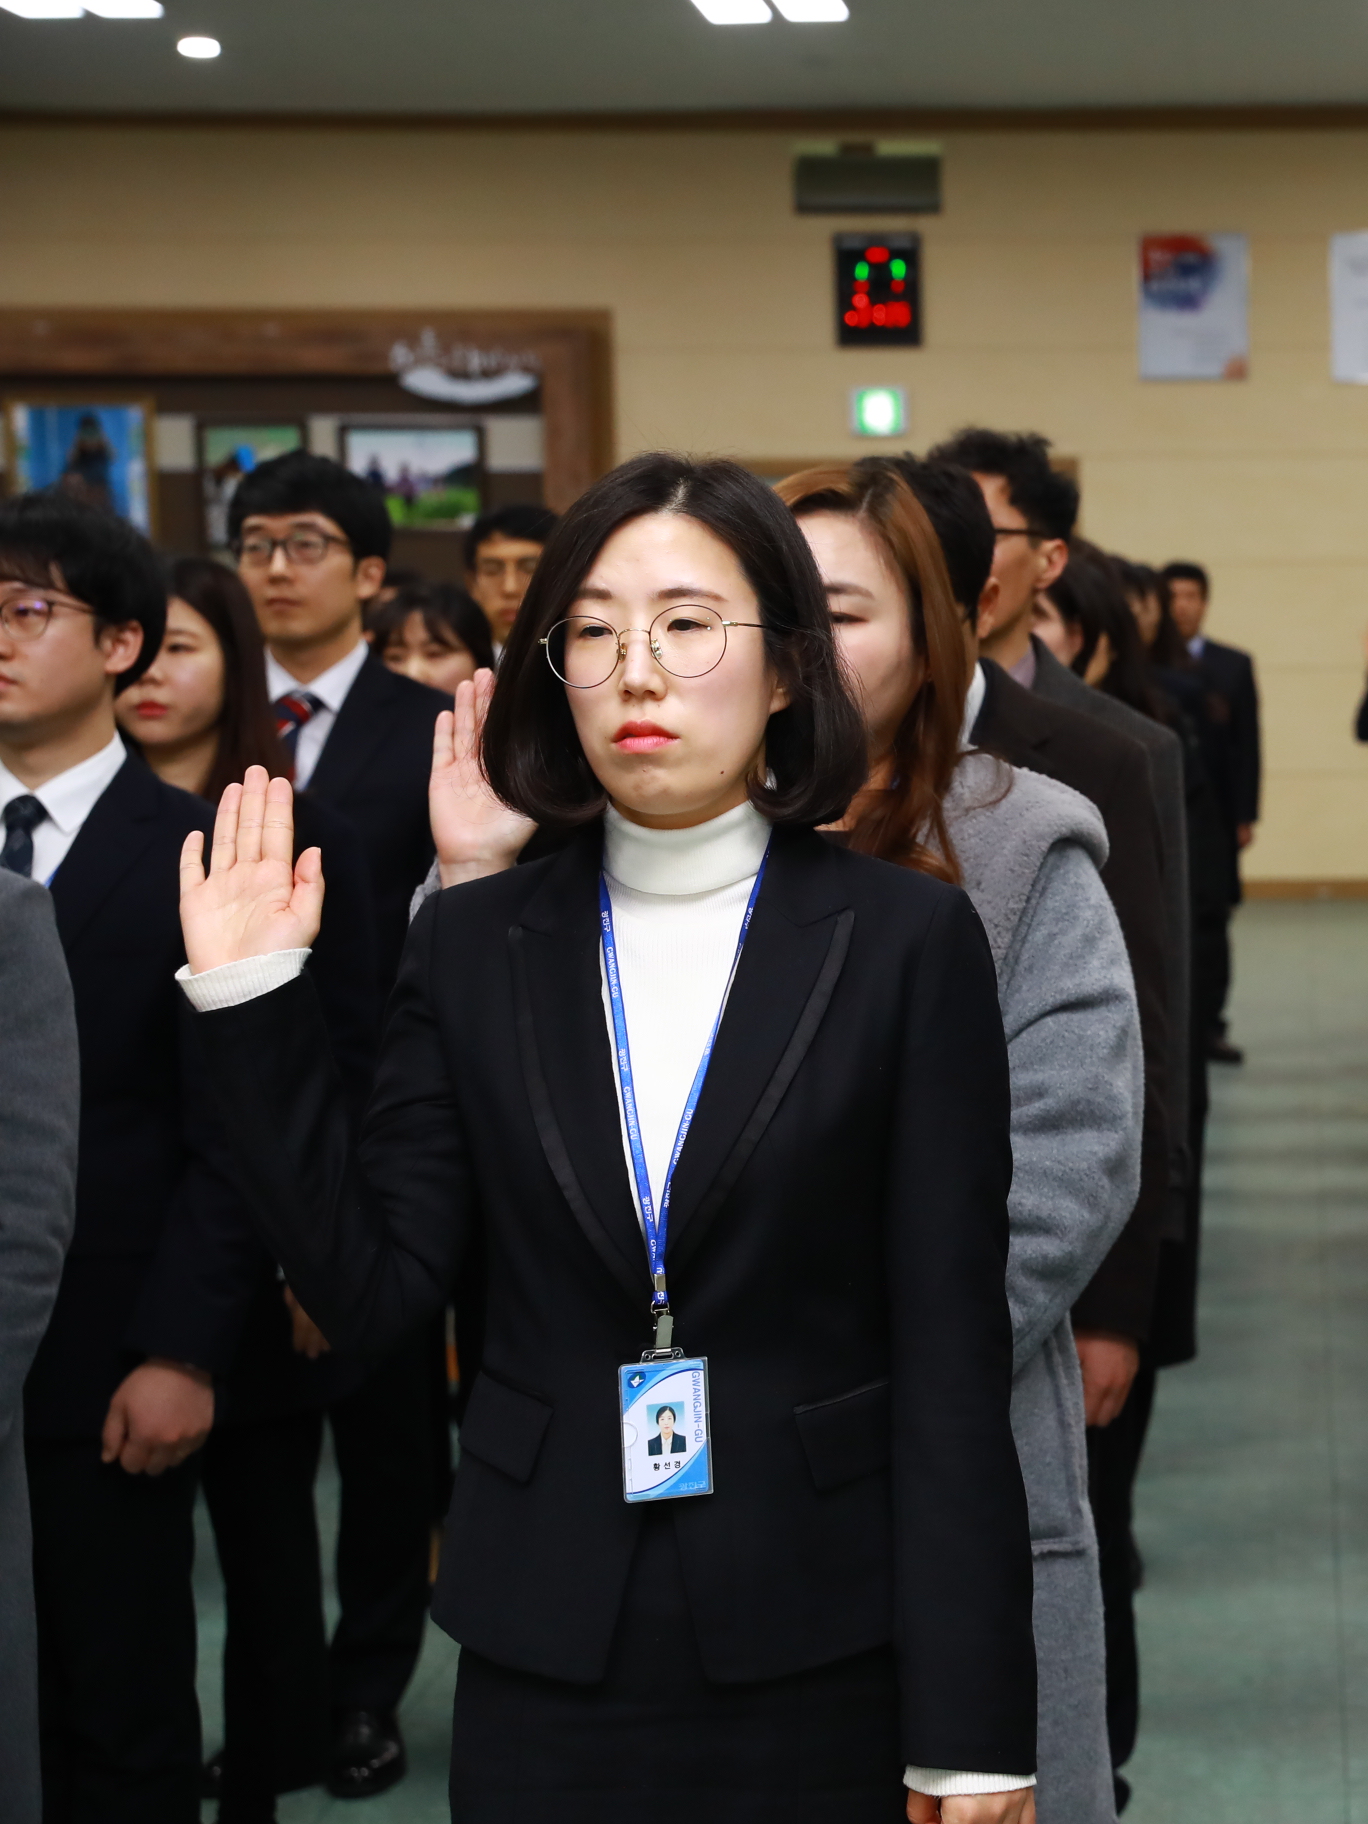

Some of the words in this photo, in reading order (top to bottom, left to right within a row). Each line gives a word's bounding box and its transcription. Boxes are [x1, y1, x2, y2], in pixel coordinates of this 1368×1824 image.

[618, 1048, 629, 1072] 광진구
[623, 1086, 638, 1140] GWANGJIN-GU
[642, 1196, 654, 1222] 광진구
[691, 1371, 704, 1443] GWANGJIN-GU
